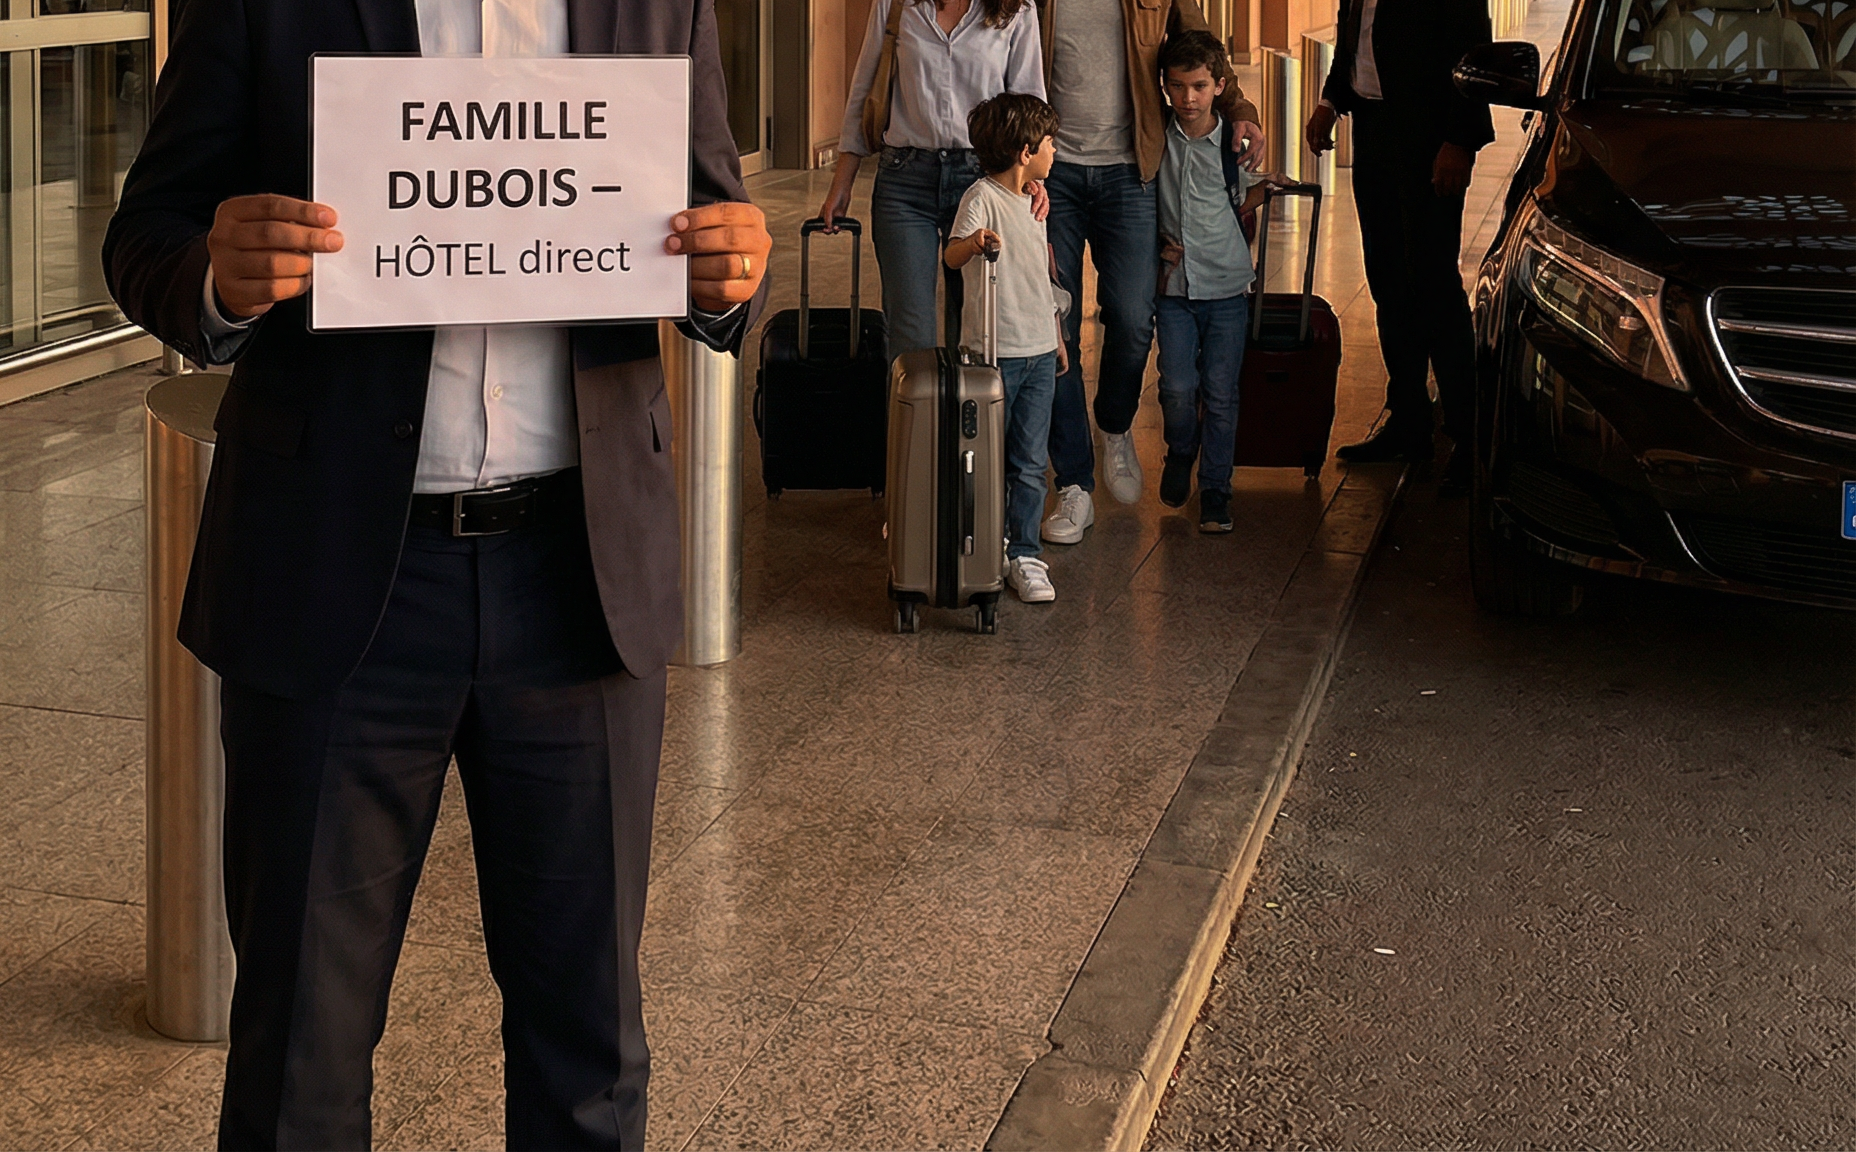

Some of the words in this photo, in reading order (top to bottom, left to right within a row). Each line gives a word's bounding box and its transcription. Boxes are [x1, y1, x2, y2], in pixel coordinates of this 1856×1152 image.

[402, 101, 607, 141] FAMILLE
[388, 168, 578, 210] DUBOIS
[375, 234, 507, 278] HÔTEL
[519, 239, 631, 274] direct
